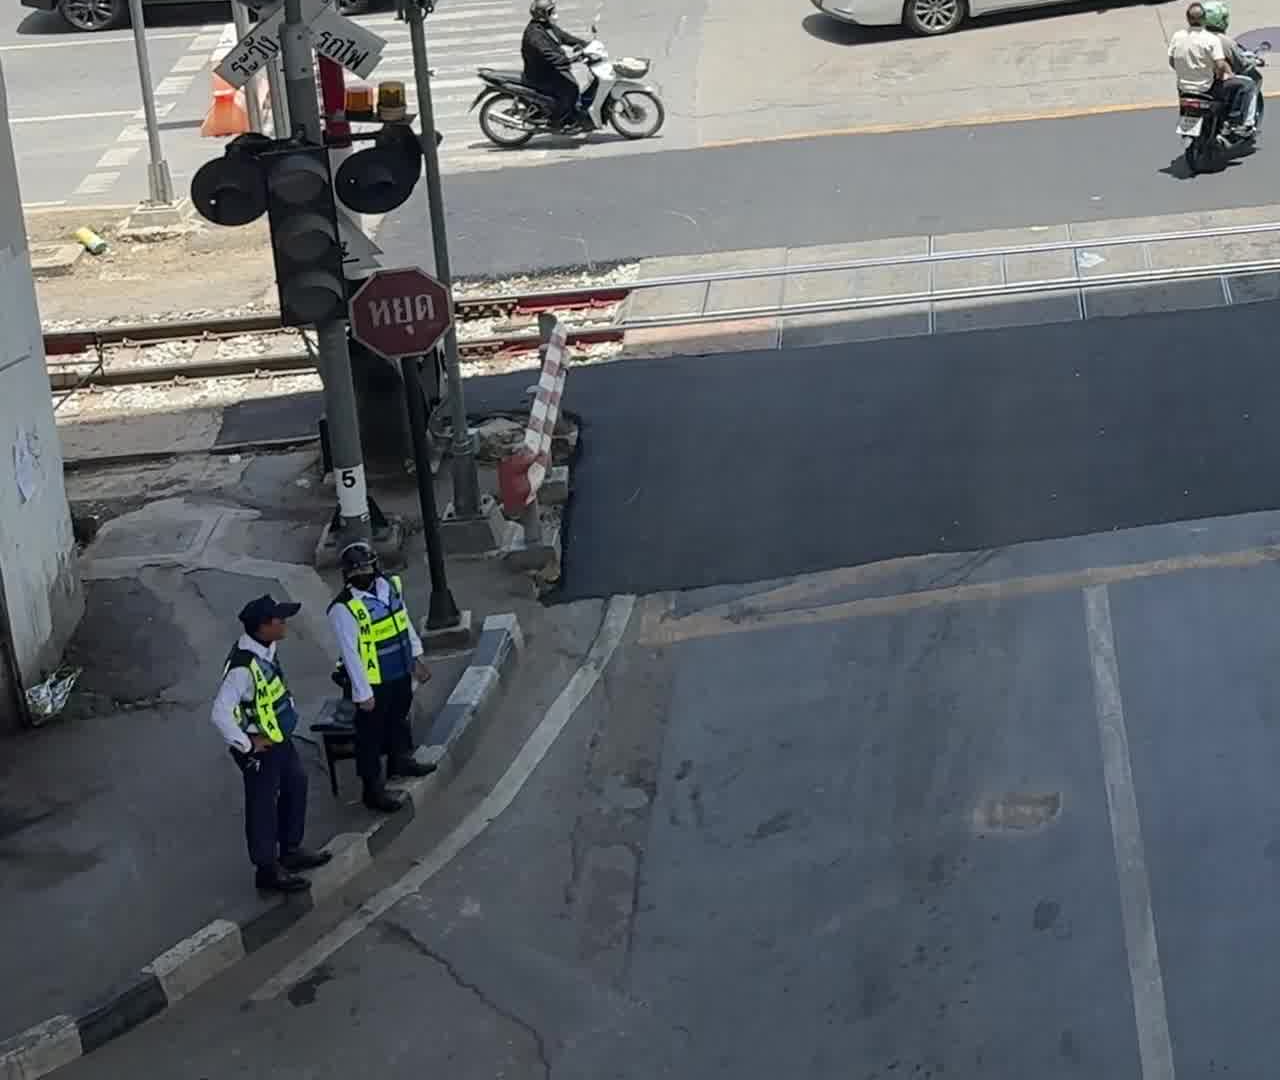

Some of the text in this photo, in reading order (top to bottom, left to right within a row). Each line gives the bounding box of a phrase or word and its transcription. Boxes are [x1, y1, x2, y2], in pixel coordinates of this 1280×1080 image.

[230, 35, 281, 76] ระวัง
[316, 31, 369, 71] รถไฟ
[367, 293, 435, 336] หยุด
[341, 469, 356, 489] 5
[356, 607, 378, 671] BMTA
